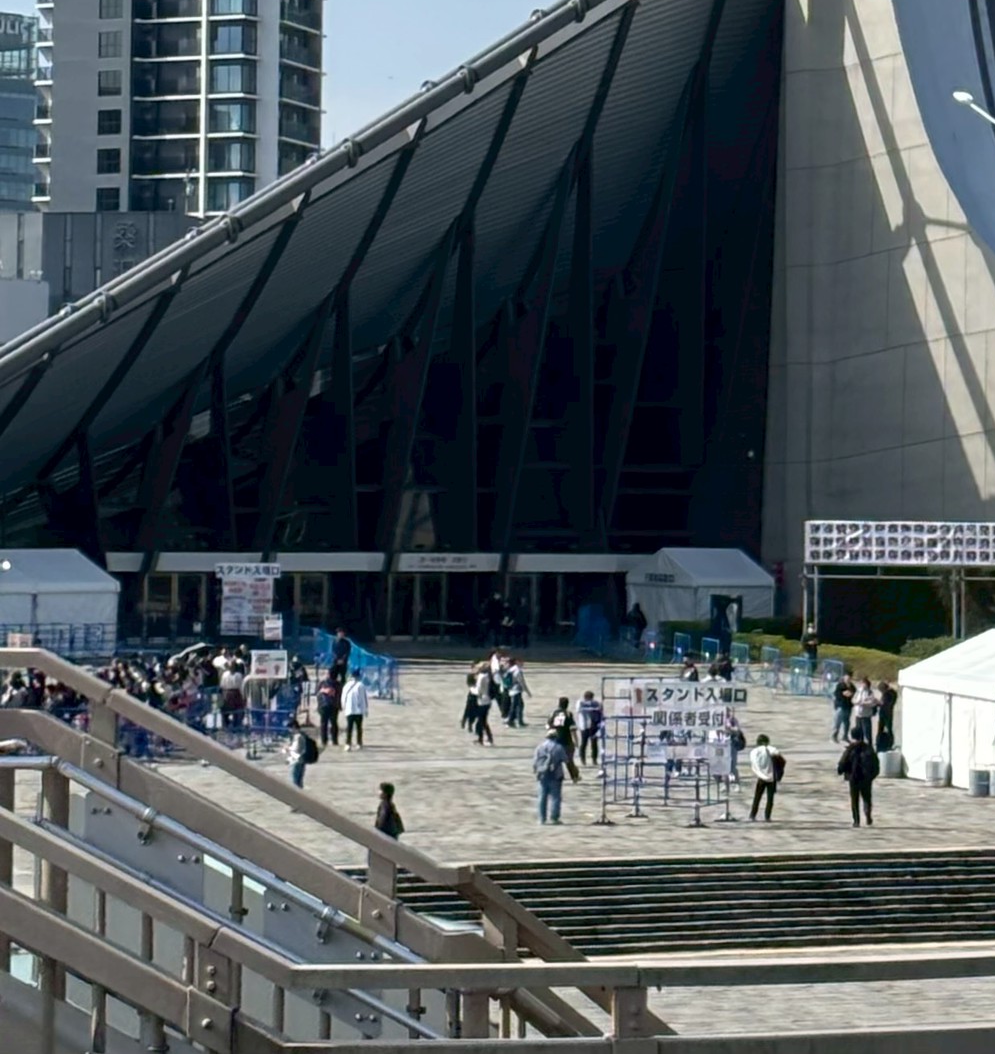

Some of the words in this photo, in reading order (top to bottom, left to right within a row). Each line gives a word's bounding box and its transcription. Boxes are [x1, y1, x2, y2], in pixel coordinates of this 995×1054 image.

[646, 687, 747, 703] スタンド入場口
[653, 710, 724, 726] 関係者受付
